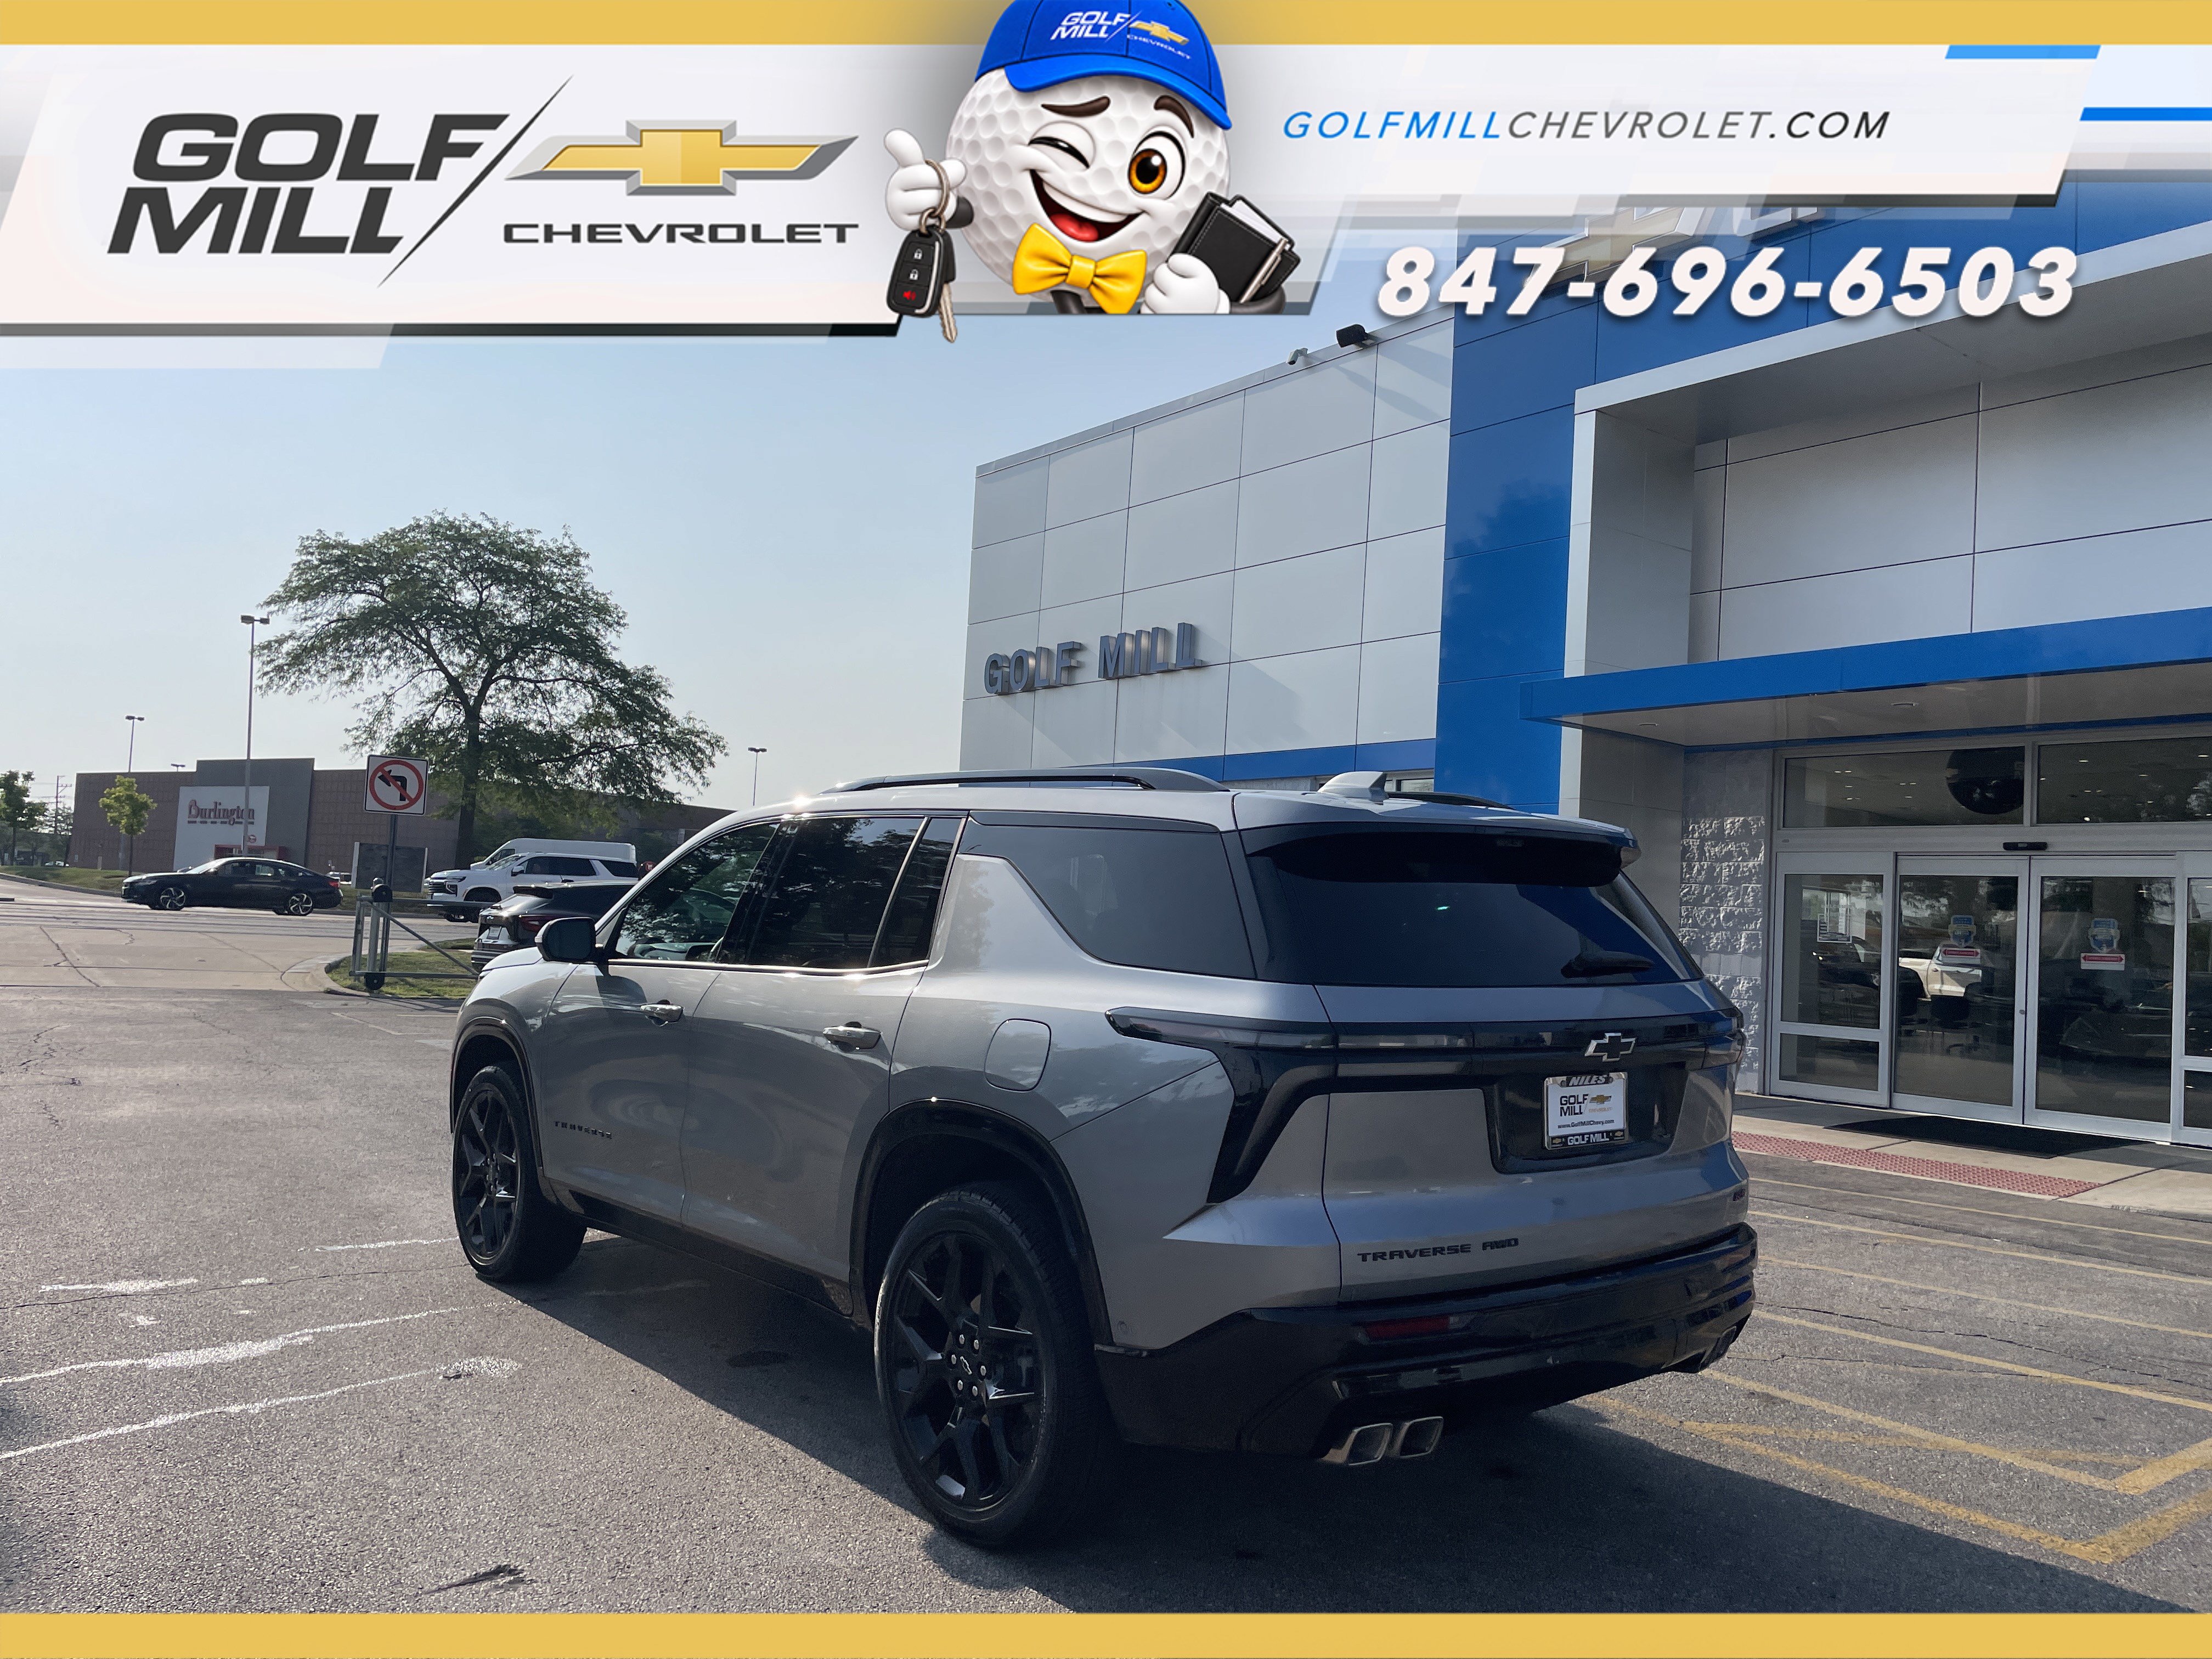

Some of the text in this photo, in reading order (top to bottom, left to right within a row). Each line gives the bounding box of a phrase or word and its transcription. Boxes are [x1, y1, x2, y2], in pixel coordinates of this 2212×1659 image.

[984, 622, 1203, 695] GOLF MILL
[1568, 1074, 1608, 1086] NILES
[1560, 1094, 1589, 1105] GOLF
[1560, 1105, 1583, 1116] MILL
[1558, 1119, 1614, 1128] www.GolfMillChevy.com
[1567, 1132, 1610, 1146] GOLF MILL
[1357, 1237, 1519, 1262] TRAVERSE AWD
